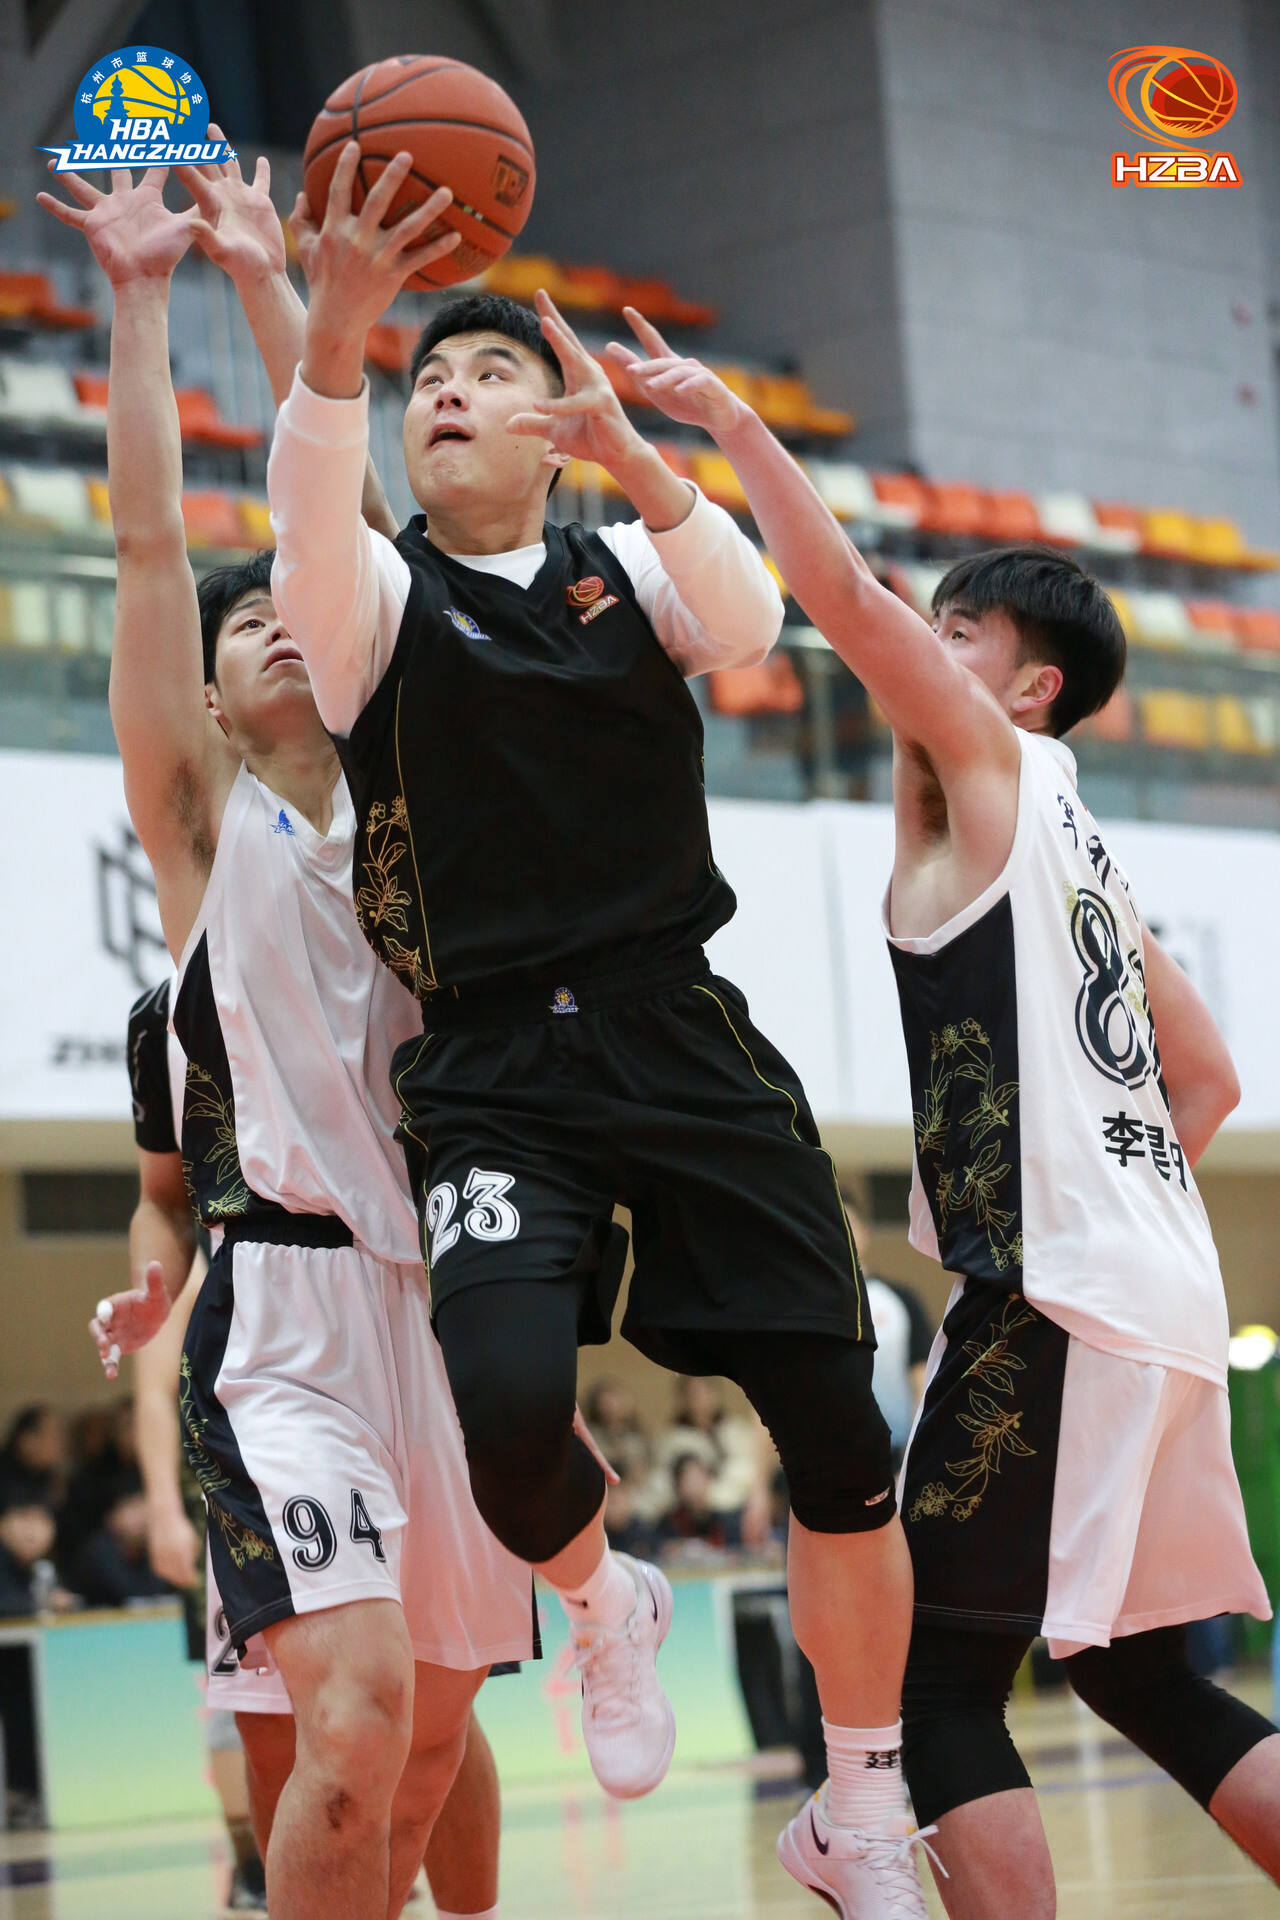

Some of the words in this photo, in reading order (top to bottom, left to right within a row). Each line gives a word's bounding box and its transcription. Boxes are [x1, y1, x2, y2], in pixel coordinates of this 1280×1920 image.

[580, 595, 617, 624] HZBA
[1070, 886, 1171, 1113] 8
[425, 1166, 521, 1270] 23
[282, 1487, 387, 1573] 94
